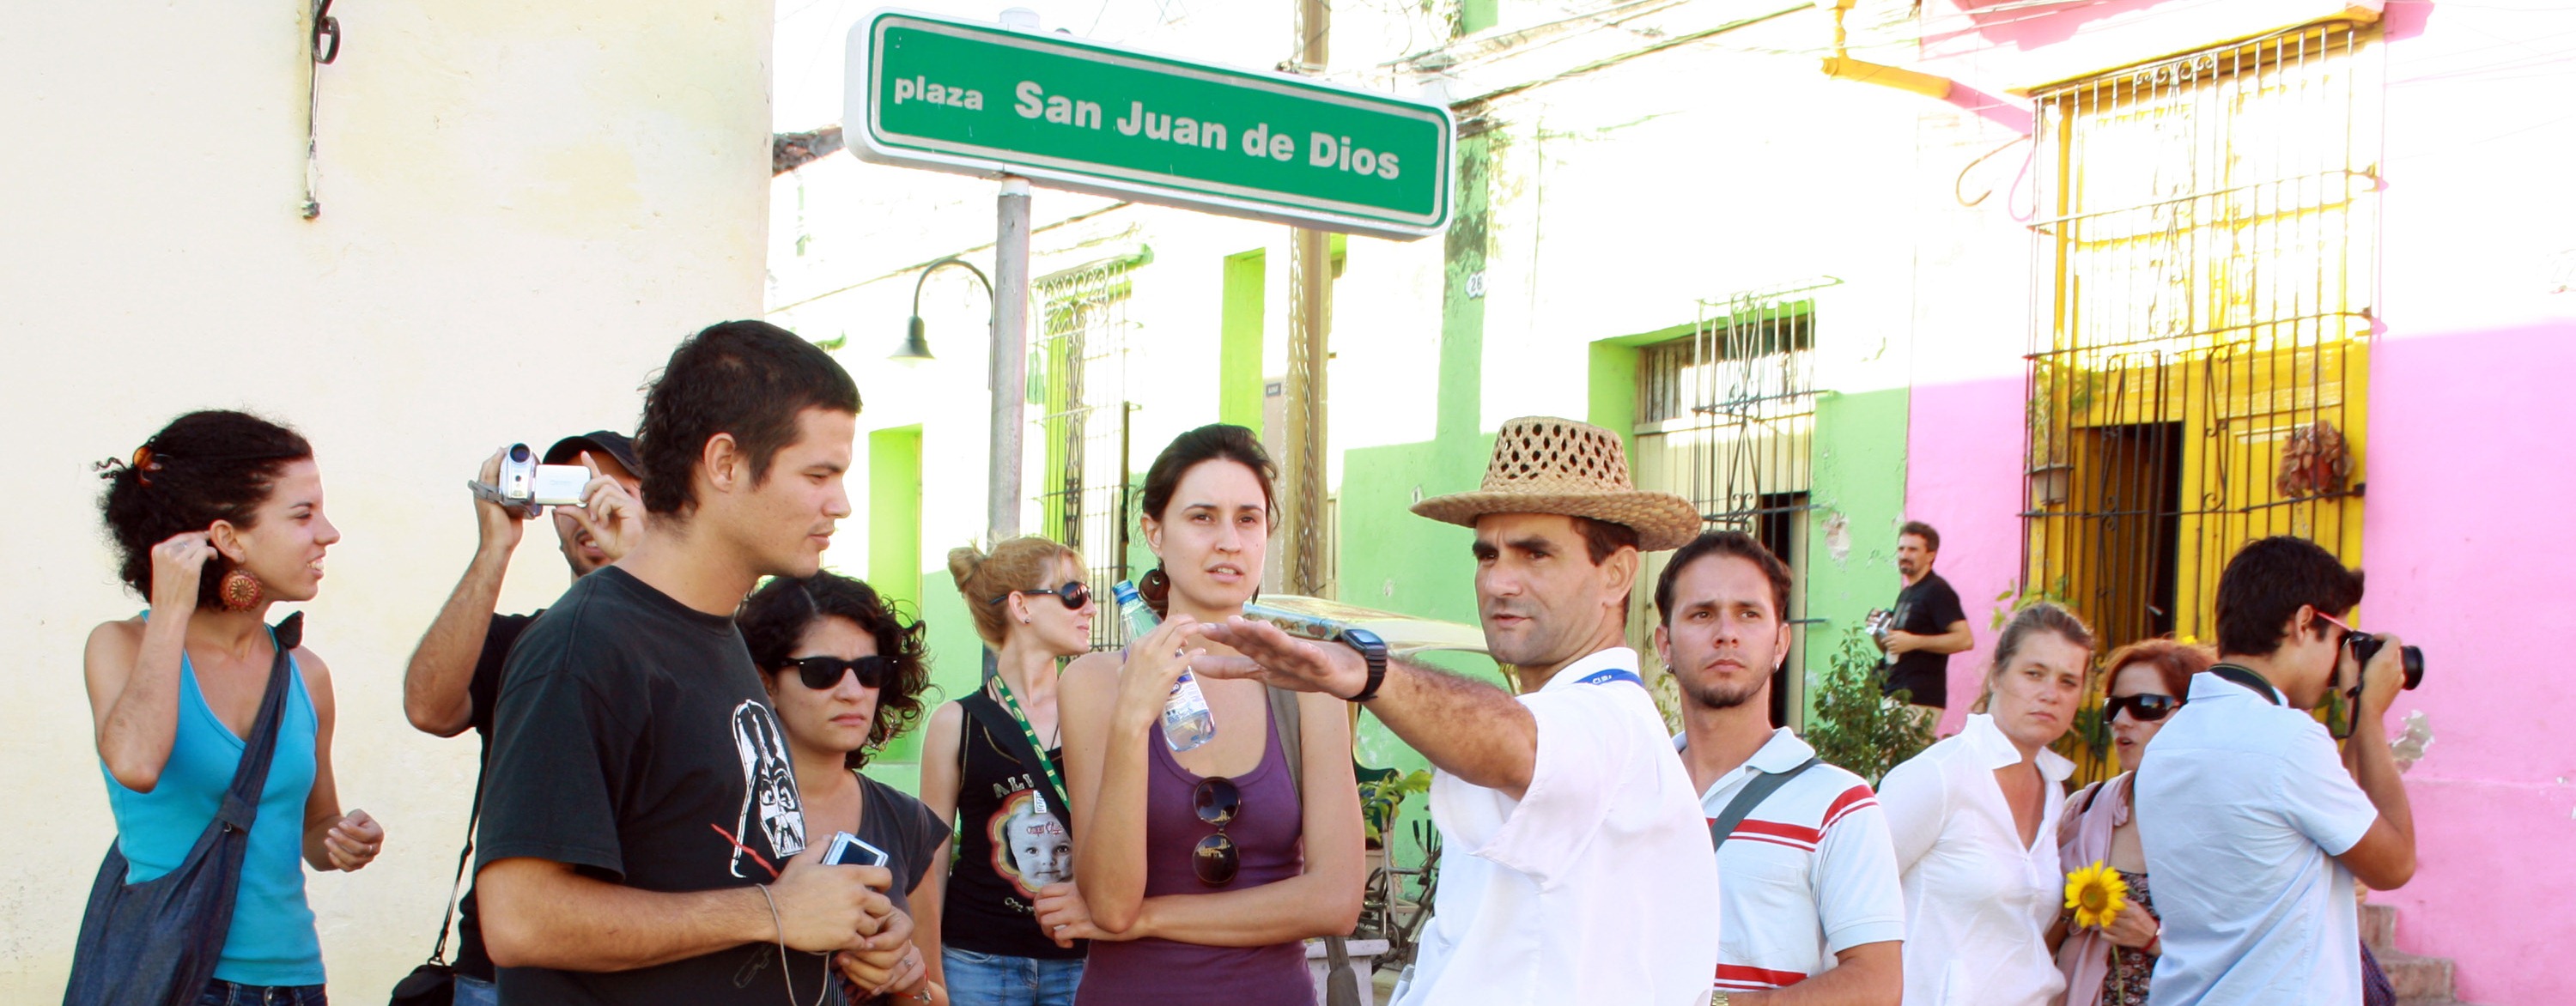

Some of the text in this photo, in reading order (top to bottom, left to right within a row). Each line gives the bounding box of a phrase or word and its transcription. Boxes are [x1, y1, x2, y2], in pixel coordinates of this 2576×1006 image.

[894, 75, 1400, 180] plaza San Juan de Dios
